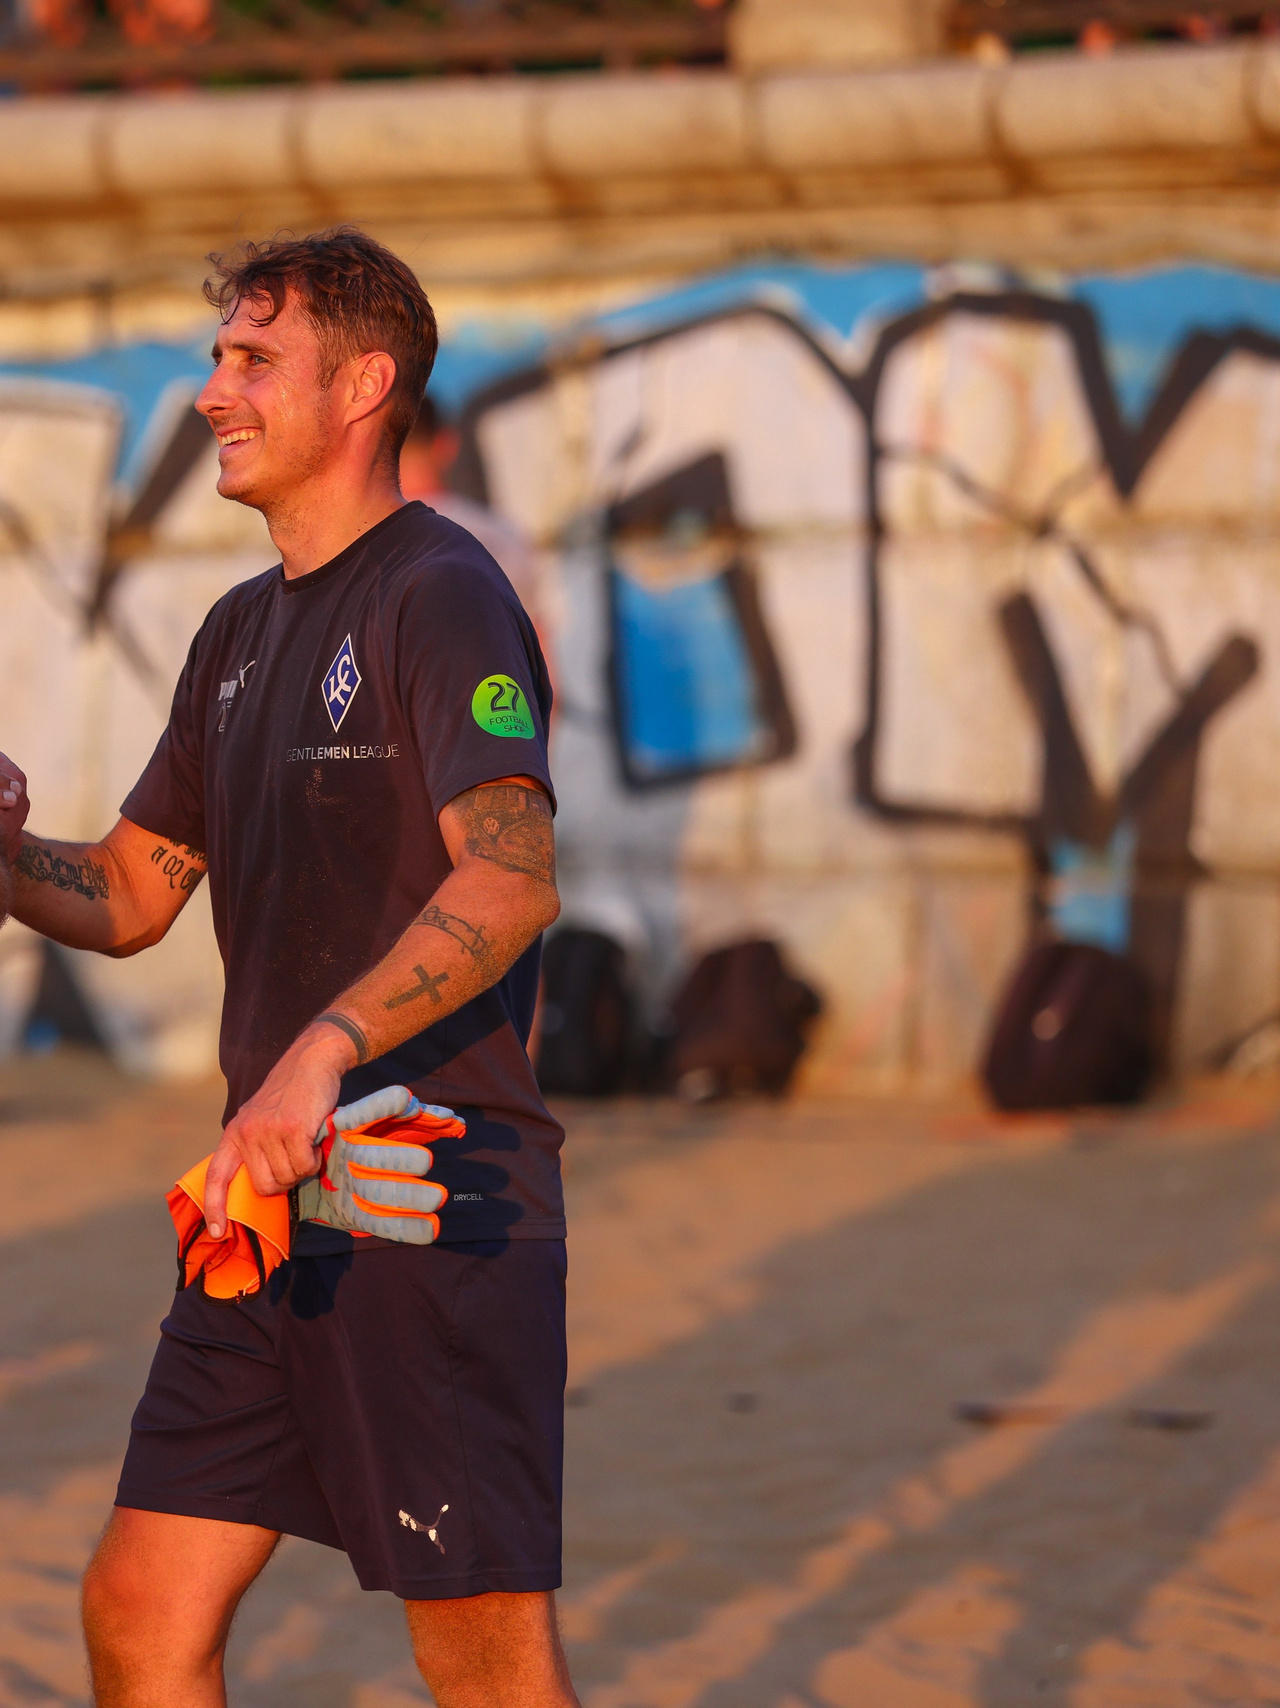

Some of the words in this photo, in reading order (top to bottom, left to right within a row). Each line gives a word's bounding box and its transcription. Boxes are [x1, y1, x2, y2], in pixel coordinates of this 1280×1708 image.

[487, 682, 519, 713] 27
[286, 746, 350, 762] GENTLEMEN
[353, 743, 400, 759] LEAGUE
[453, 1193, 484, 1201] DRYCELL
